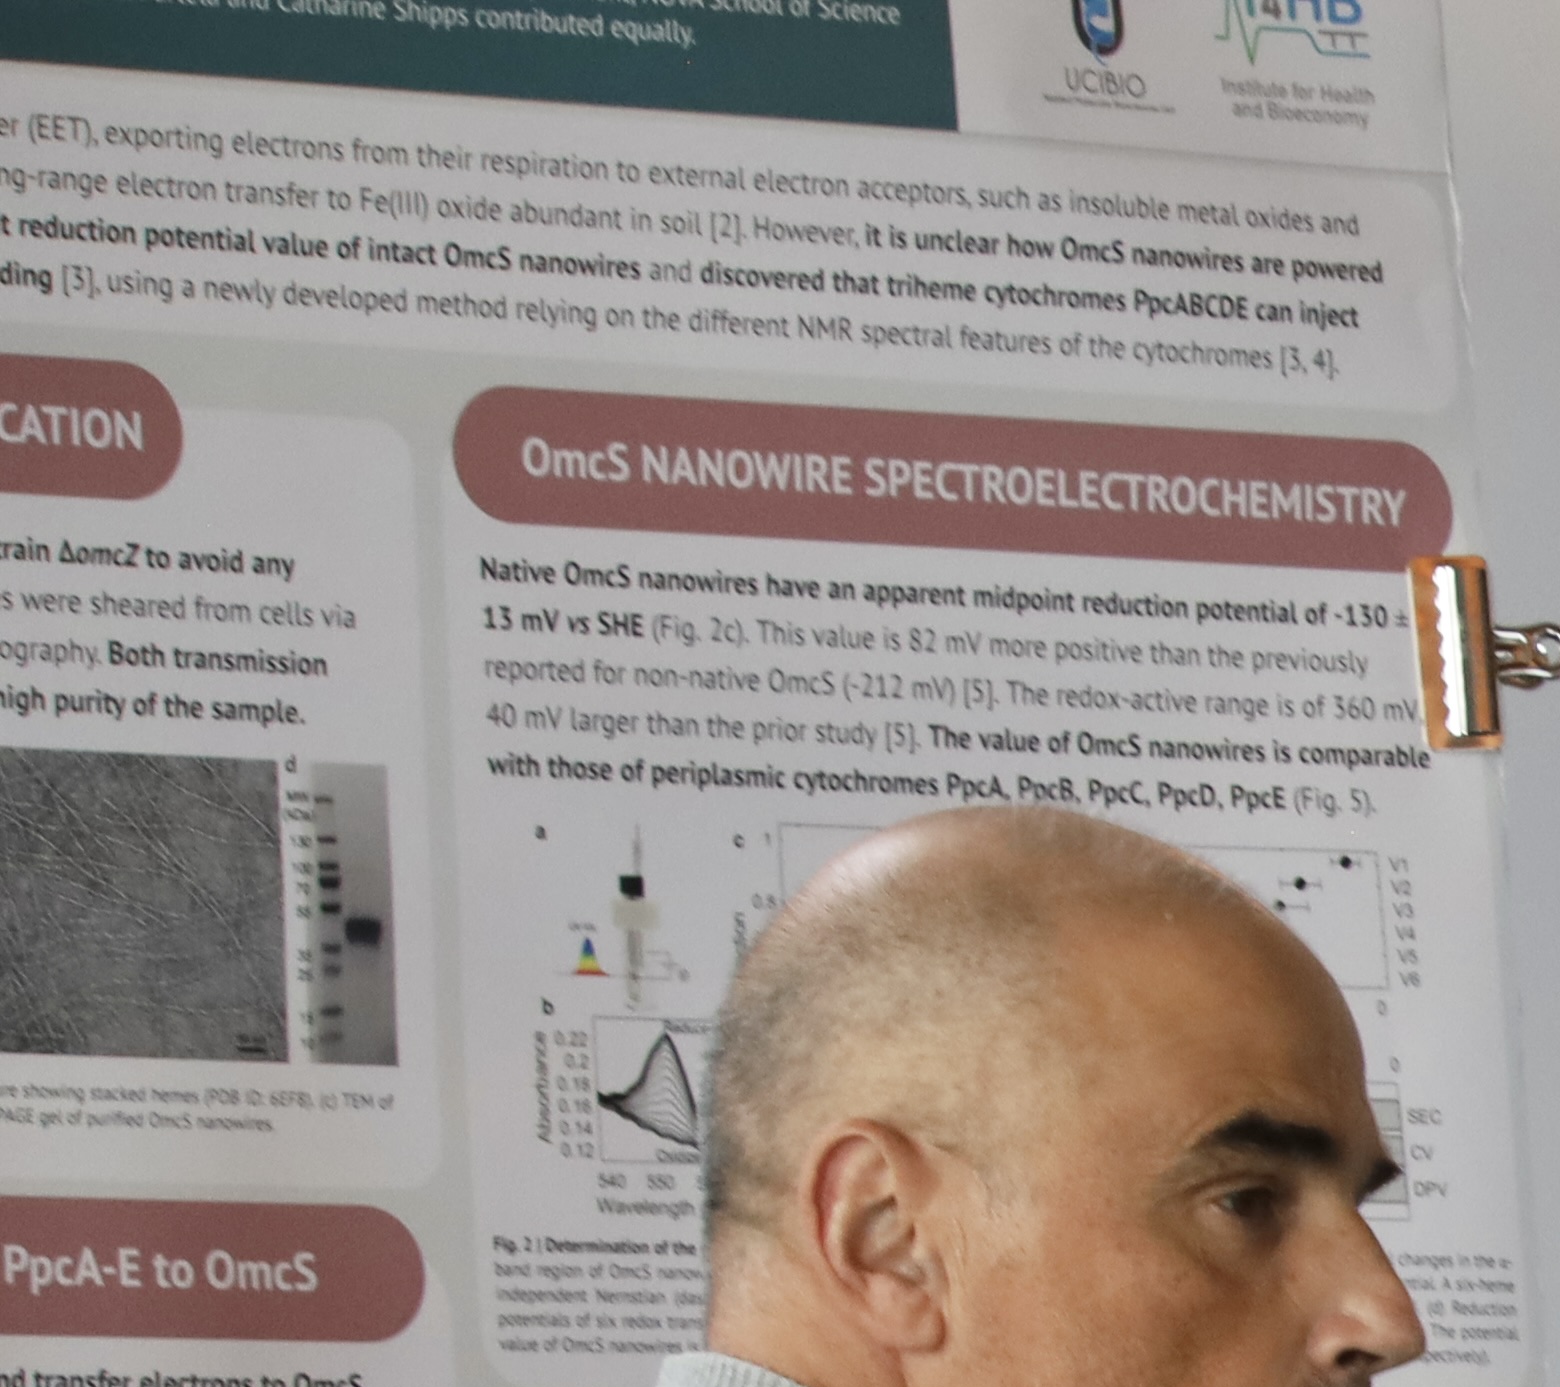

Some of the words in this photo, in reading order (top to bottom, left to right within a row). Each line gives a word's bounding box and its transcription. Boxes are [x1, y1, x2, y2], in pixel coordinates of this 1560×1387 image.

[392, 0, 469, 30] Shipps
[475, 8, 604, 38] contributed
[817, 0, 900, 25] Science
[1064, 67, 1147, 99] UCIBIO
[116, 172, 216, 200] electron
[225, 181, 319, 208] transfer
[326, 189, 351, 211] to
[360, 187, 428, 220] Fe(III)
[510, 200, 622, 231] abundant
[631, 208, 652, 230] in
[661, 211, 702, 236] soil
[711, 212, 746, 245] [2].
[753, 216, 859, 248] However,
[865, 223, 882, 249] it
[889, 224, 908, 250] is
[914, 229, 1000, 255] unclear
[1007, 233, 1055, 259] how
[1060, 235, 1125, 265] OmcS
[1131, 246, 1245, 273] nanowires
[1251, 255, 1285, 276] are
[1291, 259, 1384, 284] powered
[19, 214, 136, 244] reduction
[145, 226, 256, 253] potential
[262, 232, 329, 258] value
[336, 235, 361, 260] of
[368, 237, 437, 266] intact
[444, 242, 512, 271] OmcS
[519, 253, 641, 280] nanowires
[649, 261, 691, 283] and
[700, 261, 825, 292] discovered
[832, 270, 880, 296] that
[887, 274, 976, 302] triheme
[984, 283, 1126, 312] cytochromes
[1134, 288, 1248, 320] PpcABCDE
[1255, 303, 1293, 323] can
[1300, 301, 1359, 331] inject
[522, 437, 630, 483] OmcS
[641, 445, 852, 495] NANOWIRE
[864, 458, 1406, 527] SPECTROELECTROCHEMISTRY
[145, 547, 171, 570] to
[178, 548, 244, 574] avoid
[252, 556, 295, 583] any
[20, 593, 82, 614] were
[90, 591, 186, 620] sheared
[194, 595, 251, 623] from
[259, 601, 314, 628] cells
[321, 604, 356, 629] via
[480, 556, 556, 585] Native
[564, 561, 631, 589] OmcS
[638, 570, 759, 596] nanowires
[766, 573, 820, 599] have
[828, 581, 856, 600] an
[863, 583, 966, 609] apparent
[973, 585, 1075, 615] midpoint
[1082, 592, 1189, 618] reduction
[1196, 600, 1298, 625] potential
[1304, 601, 1327, 625] of
[1335, 603, 1388, 629] -130
[108, 639, 165, 667] Both
[173, 647, 327, 676] transmission
[54, 689, 126, 721] purity
[132, 691, 157, 717] of
[163, 694, 204, 719] the
[212, 699, 305, 728] sample.
[487, 752, 540, 777] with
[547, 755, 613, 782] those
[620, 758, 644, 783] of
[651, 761, 785, 791] periplasmic
[793, 769, 939, 796] cytochromes
[946, 772, 1011, 803] PpcA,
[1017, 776, 1081, 808] PpcB,
[1157, 781, 1224, 811] PpcD,
[1230, 784, 1286, 814] PpcE
[3, 1244, 142, 1296] PpcA-E
[152, 1254, 194, 1289] to
[205, 1249, 318, 1292] OmcS
